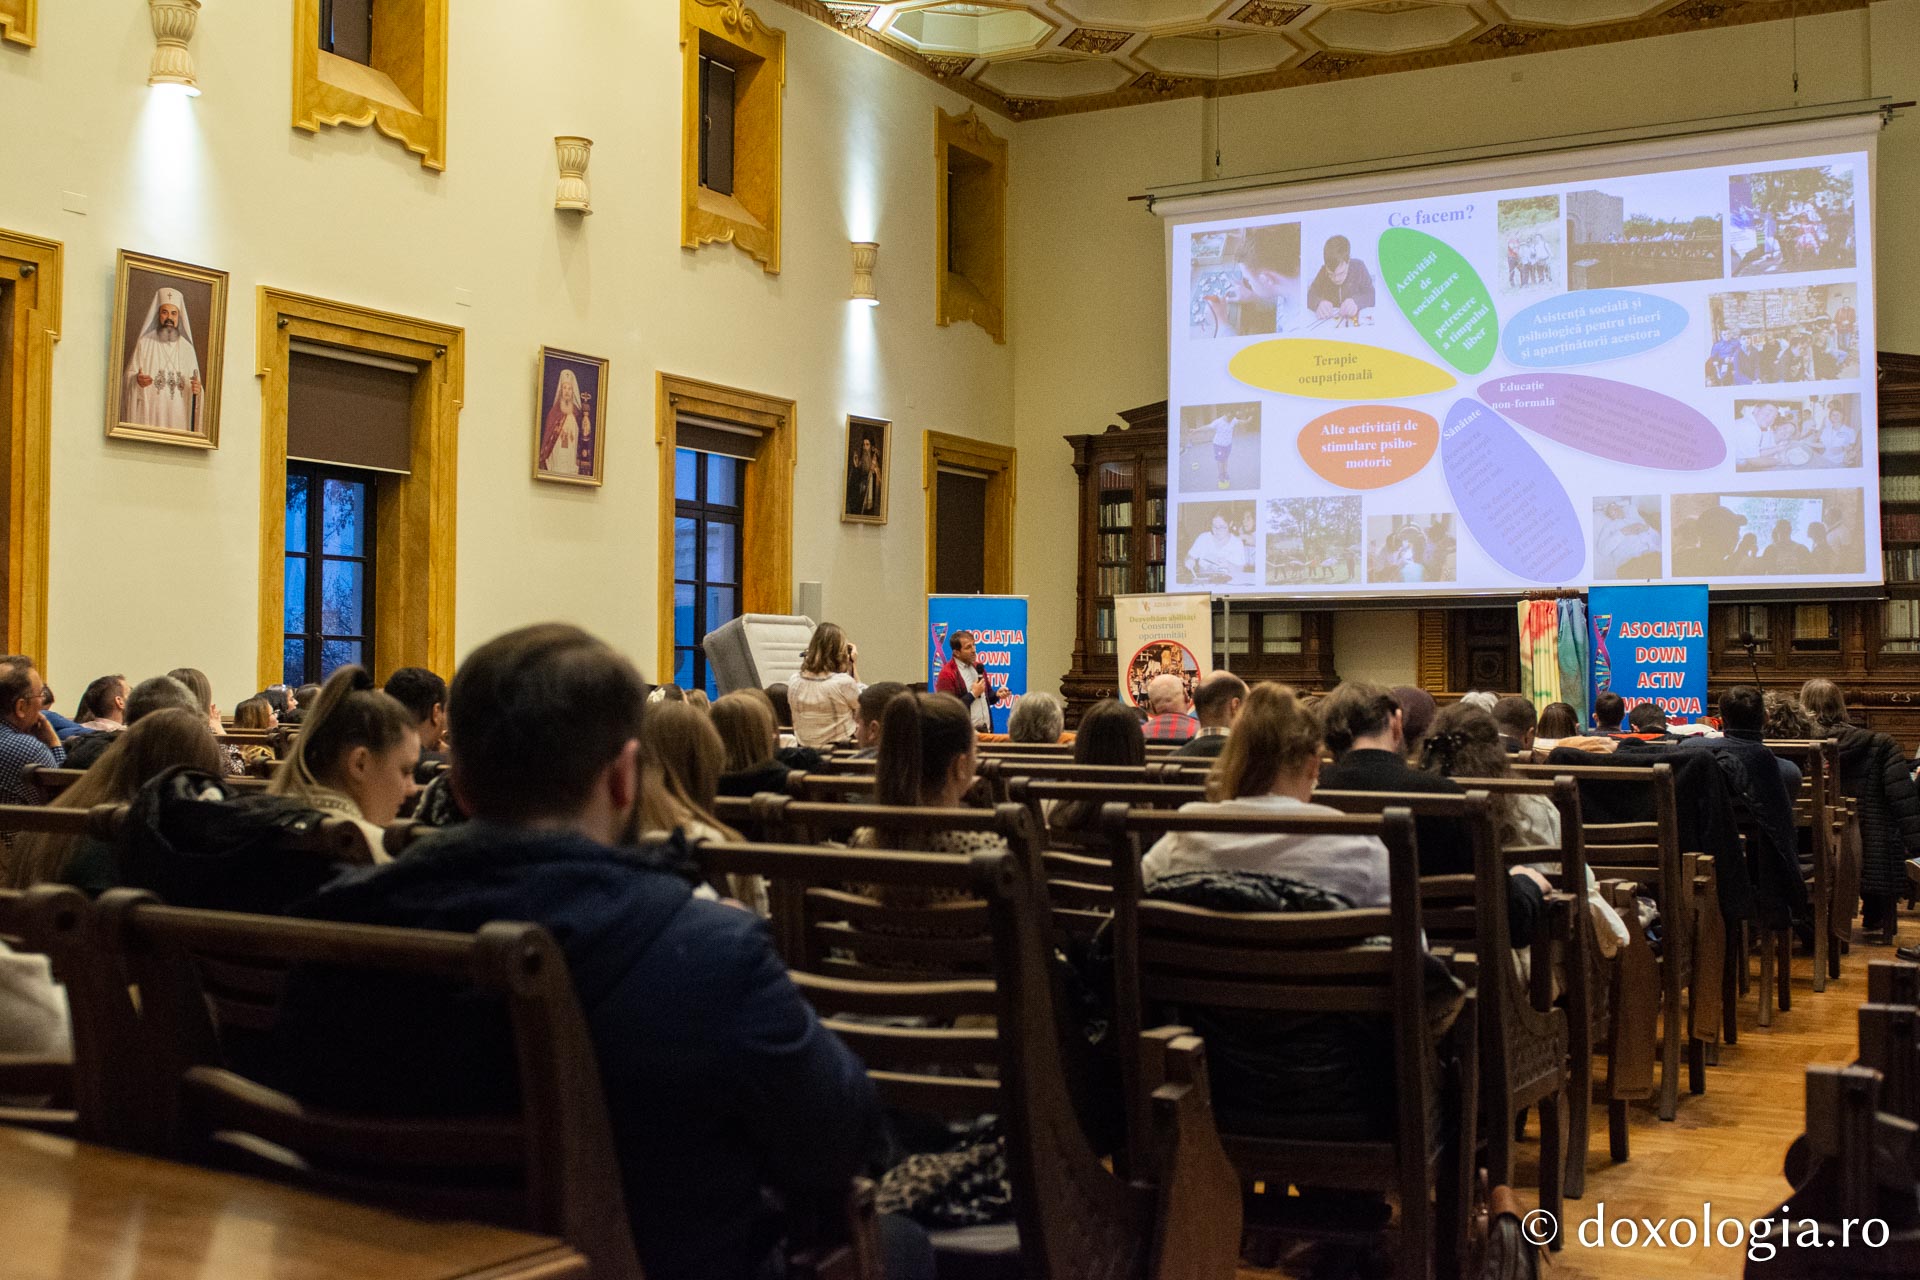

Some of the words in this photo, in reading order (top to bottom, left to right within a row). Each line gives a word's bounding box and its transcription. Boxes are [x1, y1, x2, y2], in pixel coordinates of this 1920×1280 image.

[1388, 212, 1411, 228] Ce
[1416, 204, 1475, 226] facem?
[1420, 277, 1433, 290] de
[1412, 272, 1460, 316] socializare
[1589, 300, 1629, 315] socială
[1435, 297, 1476, 338] petrecere
[1442, 342, 1451, 350] a
[1449, 304, 1489, 342] timpului
[1518, 325, 1582, 345] psihologică
[1585, 318, 1625, 334] pentru
[1628, 310, 1661, 325] tineri
[1462, 328, 1485, 350] liber
[1611, 329, 1661, 345] acestora
[1314, 354, 1358, 367] Terapie
[1298, 369, 1373, 386] ocupațională
[1500, 381, 1545, 393] Educație
[1492, 397, 1555, 410] non-formală
[1320, 424, 1344, 436] Alte
[1348, 420, 1401, 440] activități
[1404, 419, 1418, 432] de
[1443, 409, 1482, 440] Sănătate
[1321, 440, 1377, 453] stimulare
[1380, 438, 1417, 454] psiho-
[1345, 457, 1393, 469] motorie
[957, 629, 1025, 646] OCIAȚIA
[1619, 621, 1704, 641] ASOCIAȚIA
[975, 651, 1010, 666] OWN
[1635, 646, 1687, 663] DOWN
[1637, 672, 1685, 688] ACTIV
